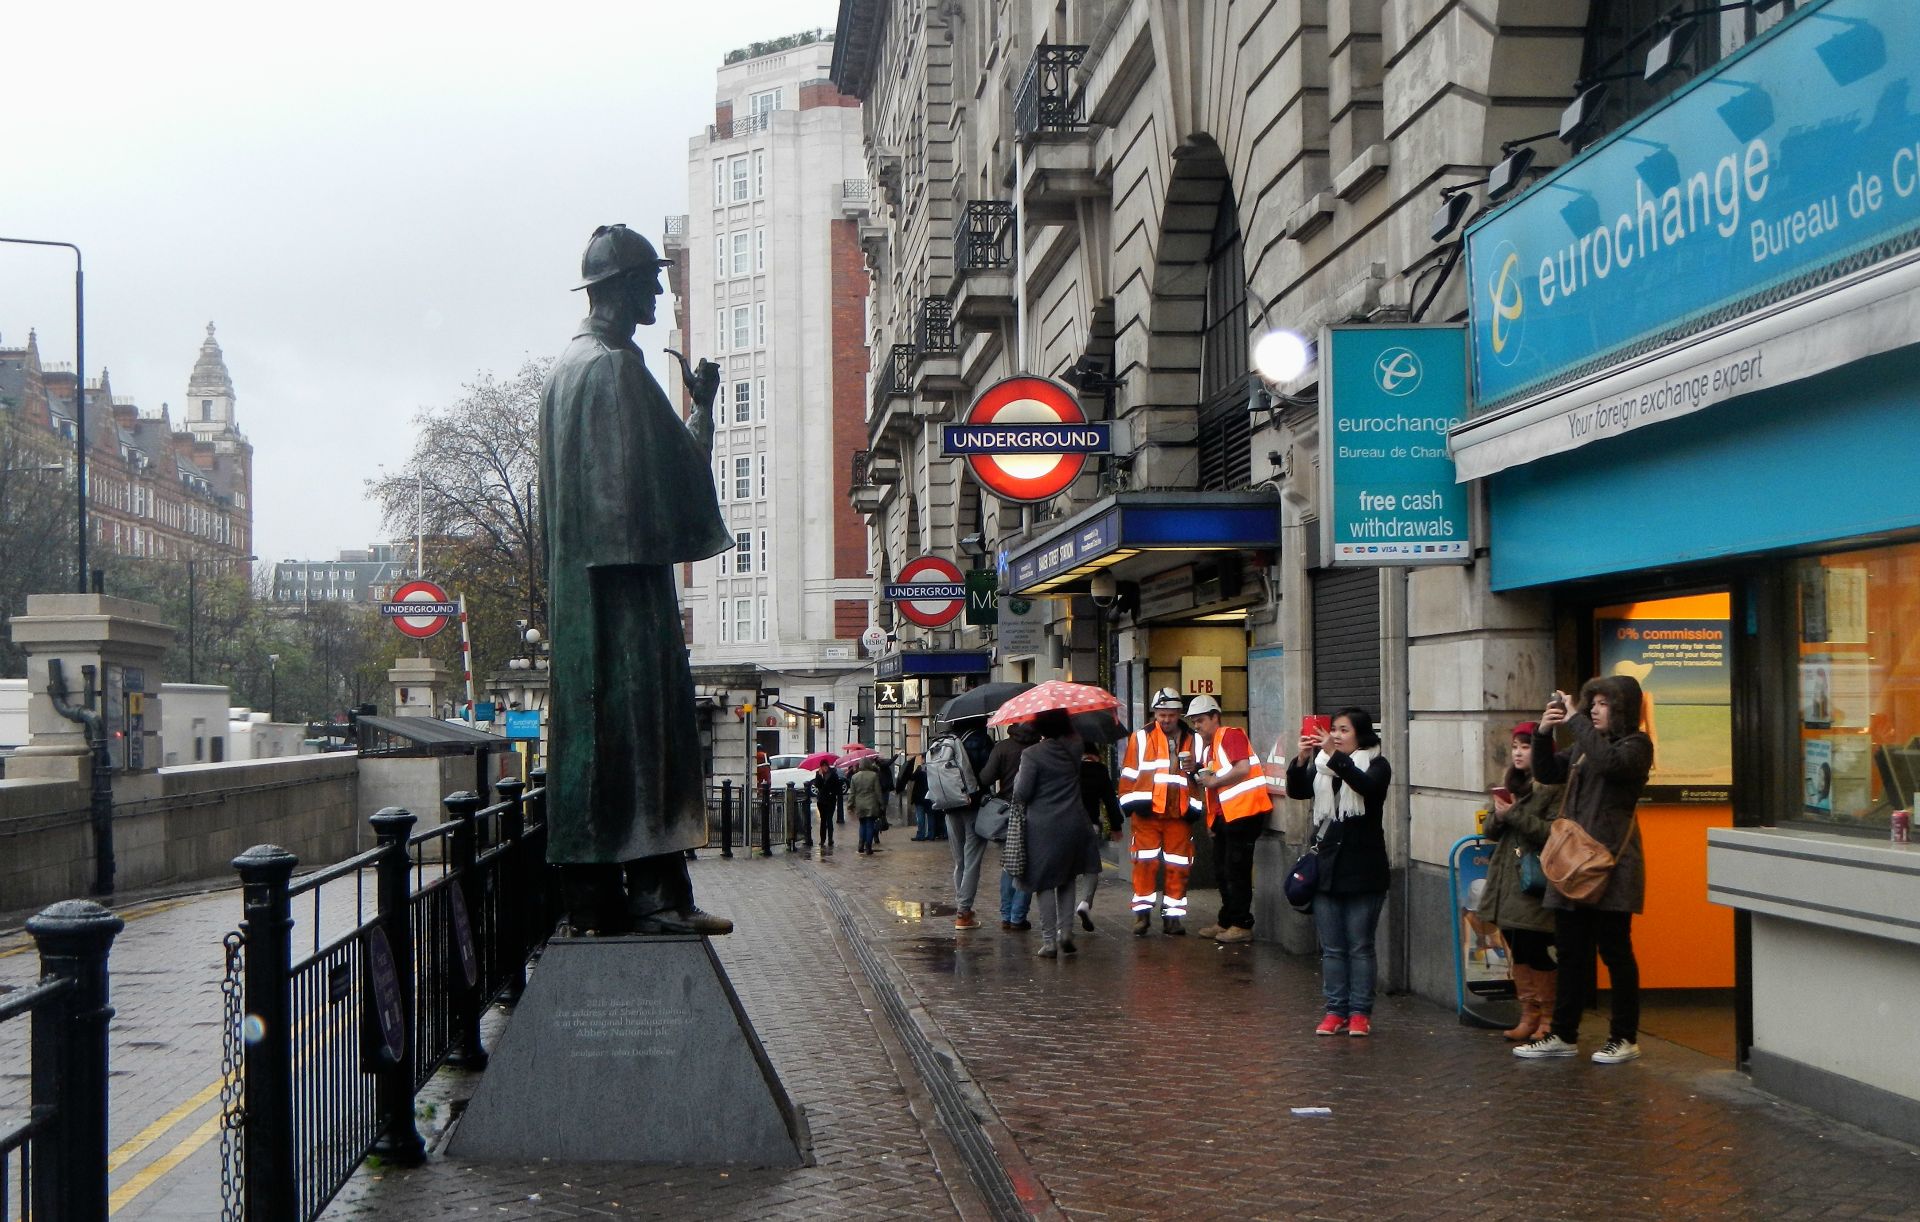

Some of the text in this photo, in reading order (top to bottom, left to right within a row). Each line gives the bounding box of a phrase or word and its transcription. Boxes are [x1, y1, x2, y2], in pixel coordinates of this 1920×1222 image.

[1751, 141, 1920, 263] Bureau de C
[1538, 138, 1770, 306] eurochange
[1568, 350, 1763, 439] Your foreign exchange expert
[1338, 414, 1461, 435] eurochange
[953, 431, 1100, 448] UNDERGROUND
[1339, 445, 1452, 461] Bureau de Chang
[1358, 490, 1443, 510] free cash
[1350, 516, 1454, 538] withdrawals
[889, 585, 967, 597] UNDERGROUN
[383, 604, 454, 615] UNDERGROUND
[1617, 627, 1723, 640] 0% commission
[865, 638, 885, 646] HSBC
[1190, 679, 1214, 694] LFB
[1690, 790, 1729, 798] eurochange
[572, 1008, 606, 1017] address
[608, 1008, 617, 1016] of
[620, 1007, 655, 1016] Sherlock
[573, 1018, 588, 1027] the
[589, 1017, 623, 1028] original
[625, 1016, 683, 1028] headquarters
[576, 1028, 609, 1038] Abbey
[611, 1027, 652, 1037] National
